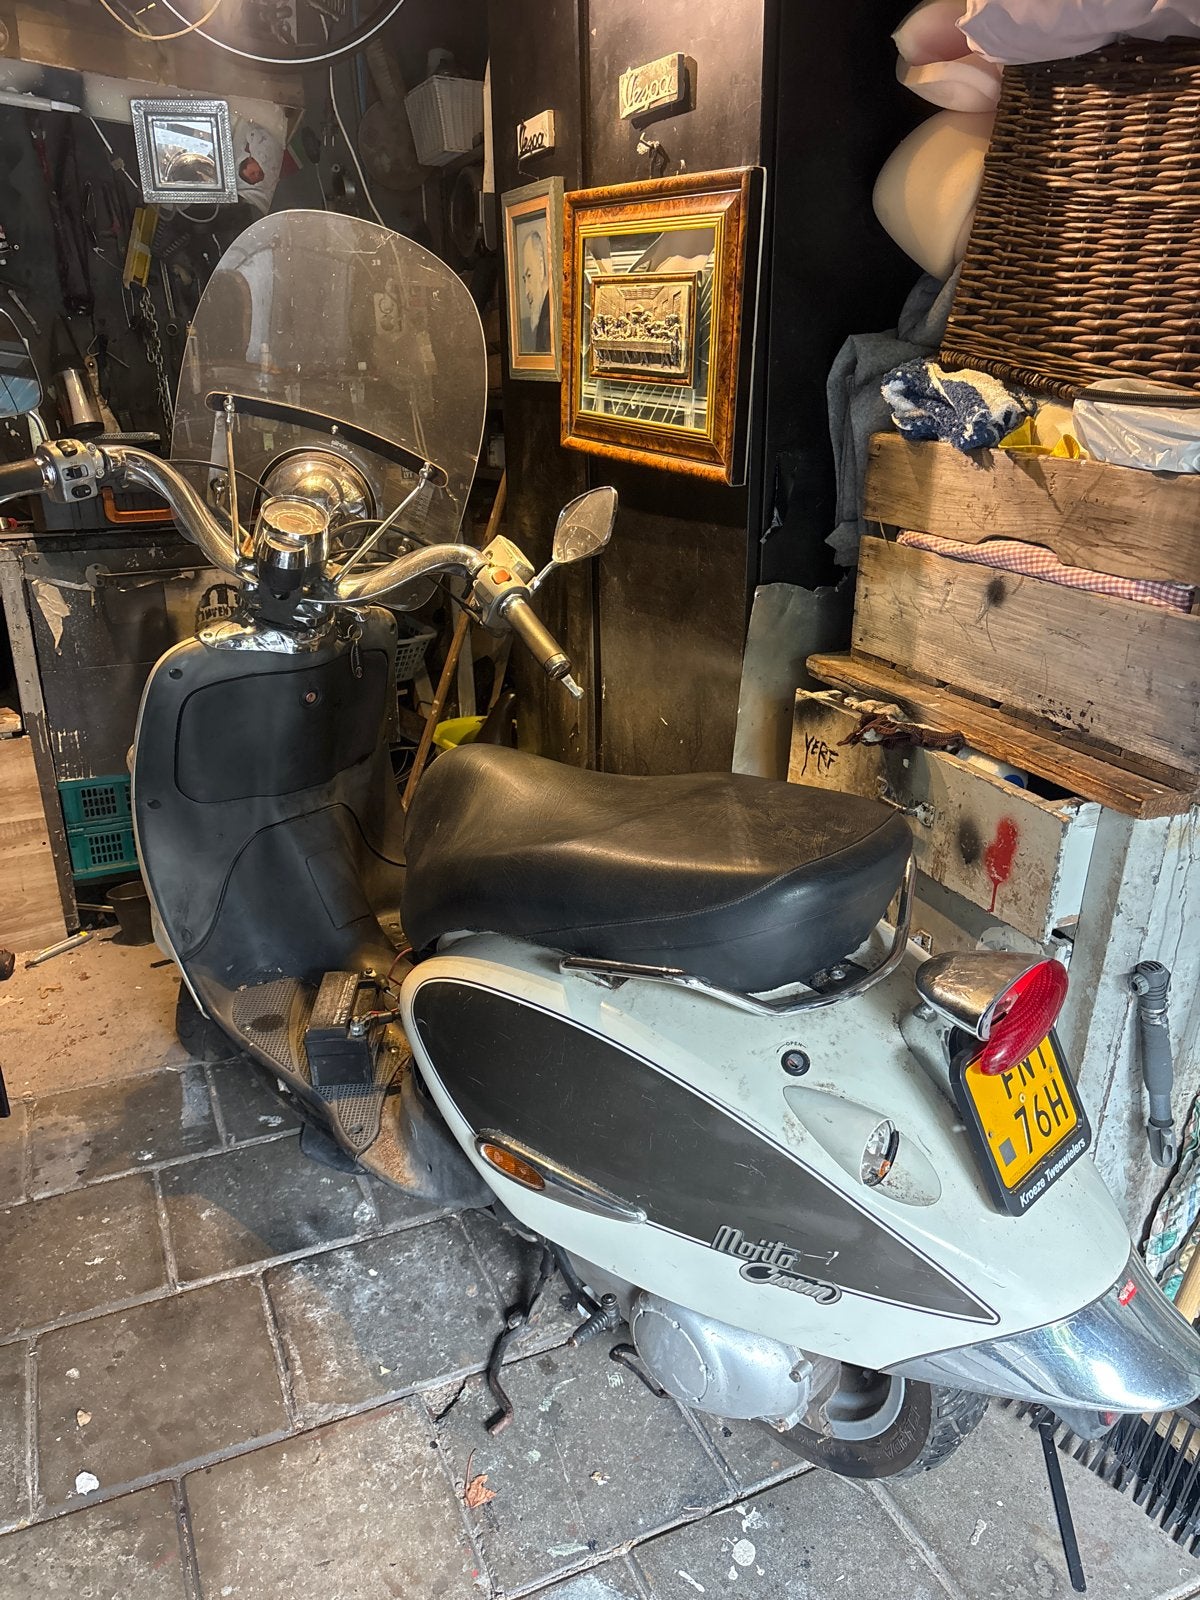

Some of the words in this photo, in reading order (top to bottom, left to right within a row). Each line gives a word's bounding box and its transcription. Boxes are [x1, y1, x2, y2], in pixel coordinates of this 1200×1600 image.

[620, 67, 679, 118] Vespa
[519, 121, 548, 157] Vespa
[785, 1040, 803, 1048] OPEN
[1014, 1078, 1069, 1154] 76H
[1019, 1178, 1046, 1208] Kroeze
[1045, 1137, 1086, 1181] Tweewielers
